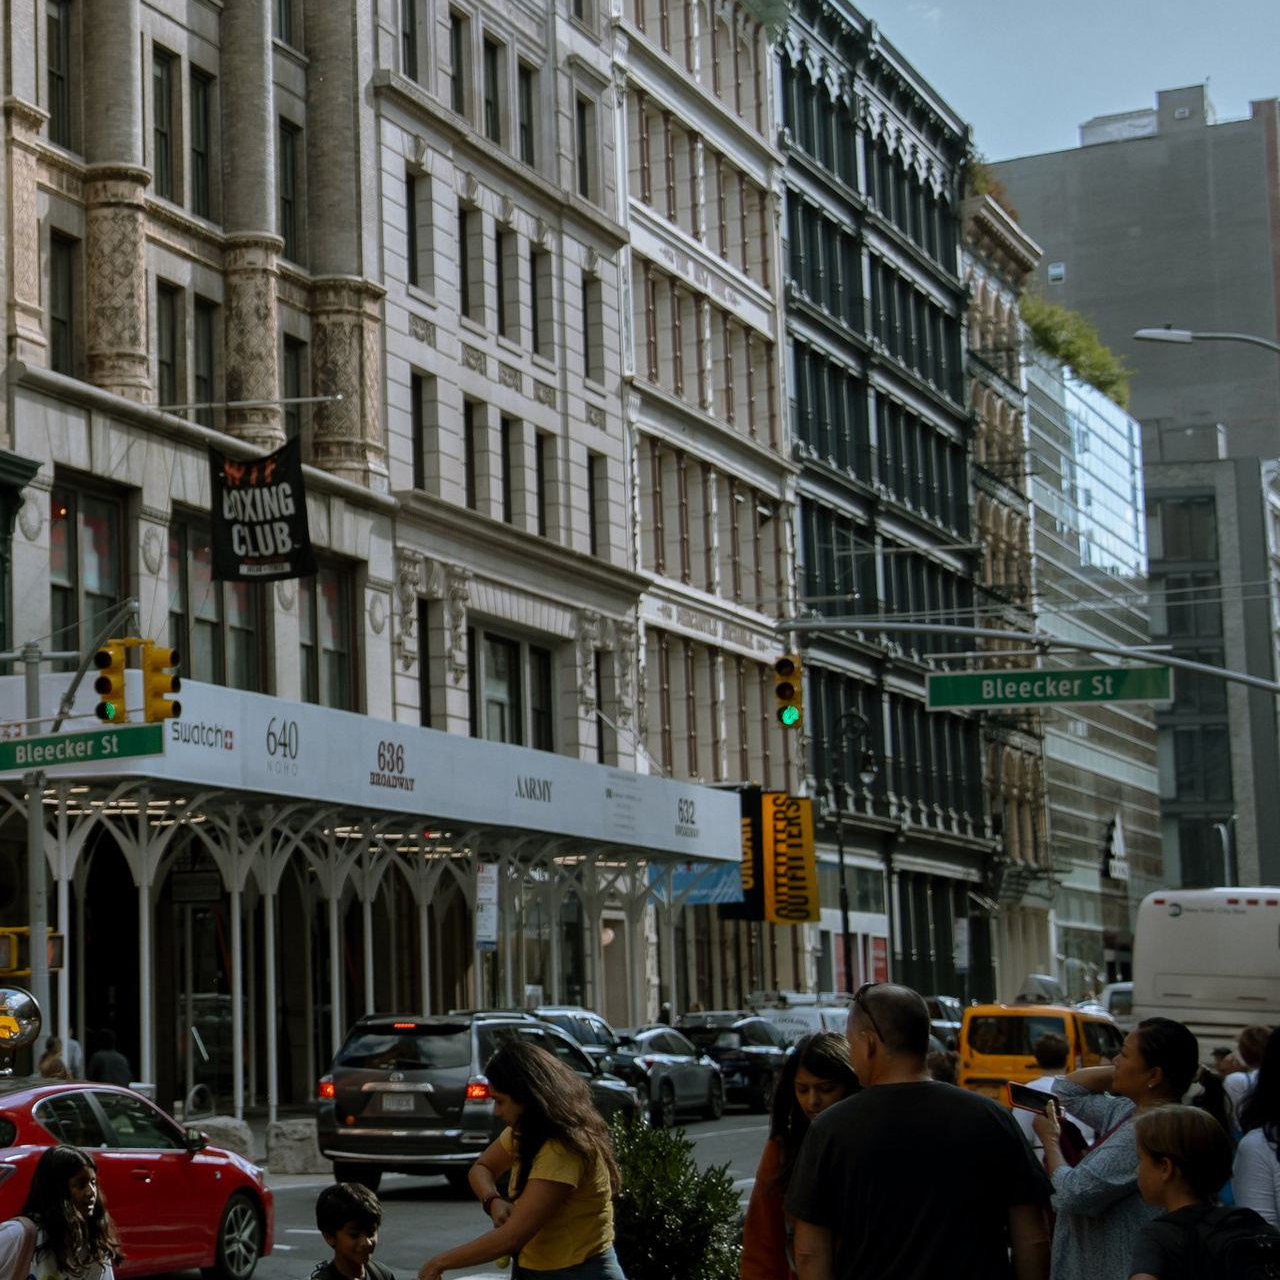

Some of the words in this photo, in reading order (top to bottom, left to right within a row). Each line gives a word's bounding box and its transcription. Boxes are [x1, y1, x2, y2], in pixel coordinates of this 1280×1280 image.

[222, 481, 296, 523] BOXING
[231, 521, 293, 557] CLUB
[981, 675, 1083, 700] Bleecker
[1091, 674, 1114, 697] St
[15, 737, 94, 764] Bleecker
[100, 734, 120, 755] St
[170, 720, 224, 749] swatch
[265, 716, 299, 760] 640
[266, 760, 299, 777] NOHO
[377, 740, 405, 774] 636
[368, 771, 415, 792] BROADWAY
[786, 799, 811, 921] OUTFITTERS
